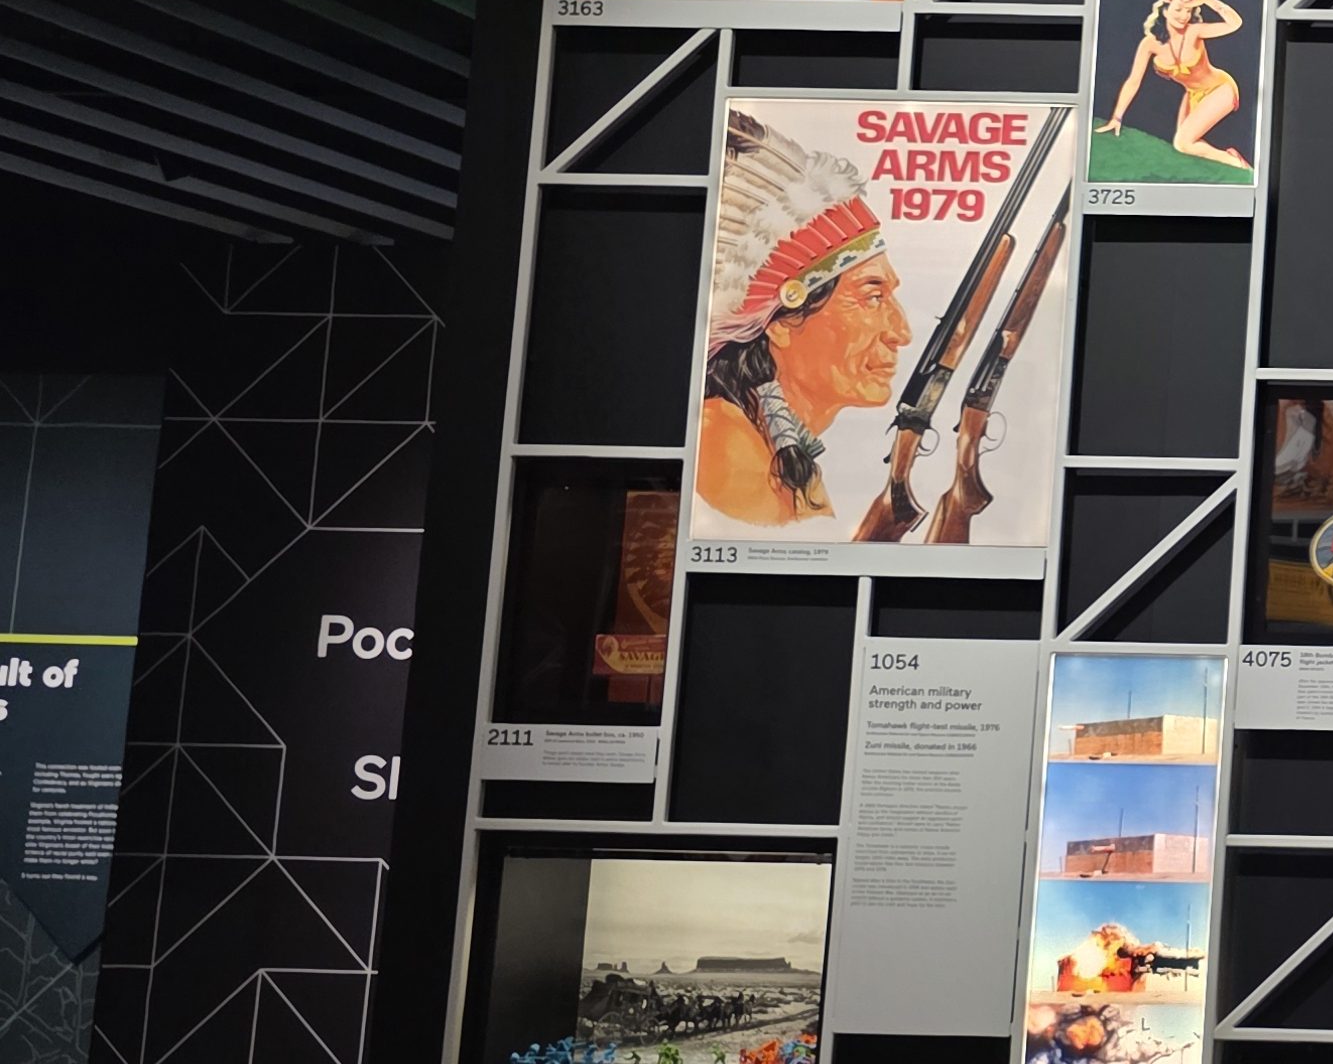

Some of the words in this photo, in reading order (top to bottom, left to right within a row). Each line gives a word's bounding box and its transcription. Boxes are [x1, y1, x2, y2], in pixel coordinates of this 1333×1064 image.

[557, 0, 604, 17] 3163
[856, 109, 1028, 147] SAVAGE
[871, 149, 1011, 183] ARMS
[888, 187, 986, 223] 1979
[1088, 189, 1136, 206] 3725
[690, 546, 738, 563] 3113
[317, 614, 415, 661] Poc
[870, 653, 920, 670] 1054
[1242, 650, 1292, 668] 4075
[43, 658, 80, 688] of
[868, 685, 925, 697] American
[927, 686, 972, 700] military
[867, 699, 917, 711] strength
[920, 700, 942, 710] and
[944, 701, 982, 712] power
[866, 720, 907, 730] Tomahawk
[487, 729, 534, 746] 2111
[864, 741, 882, 749] Zuni
